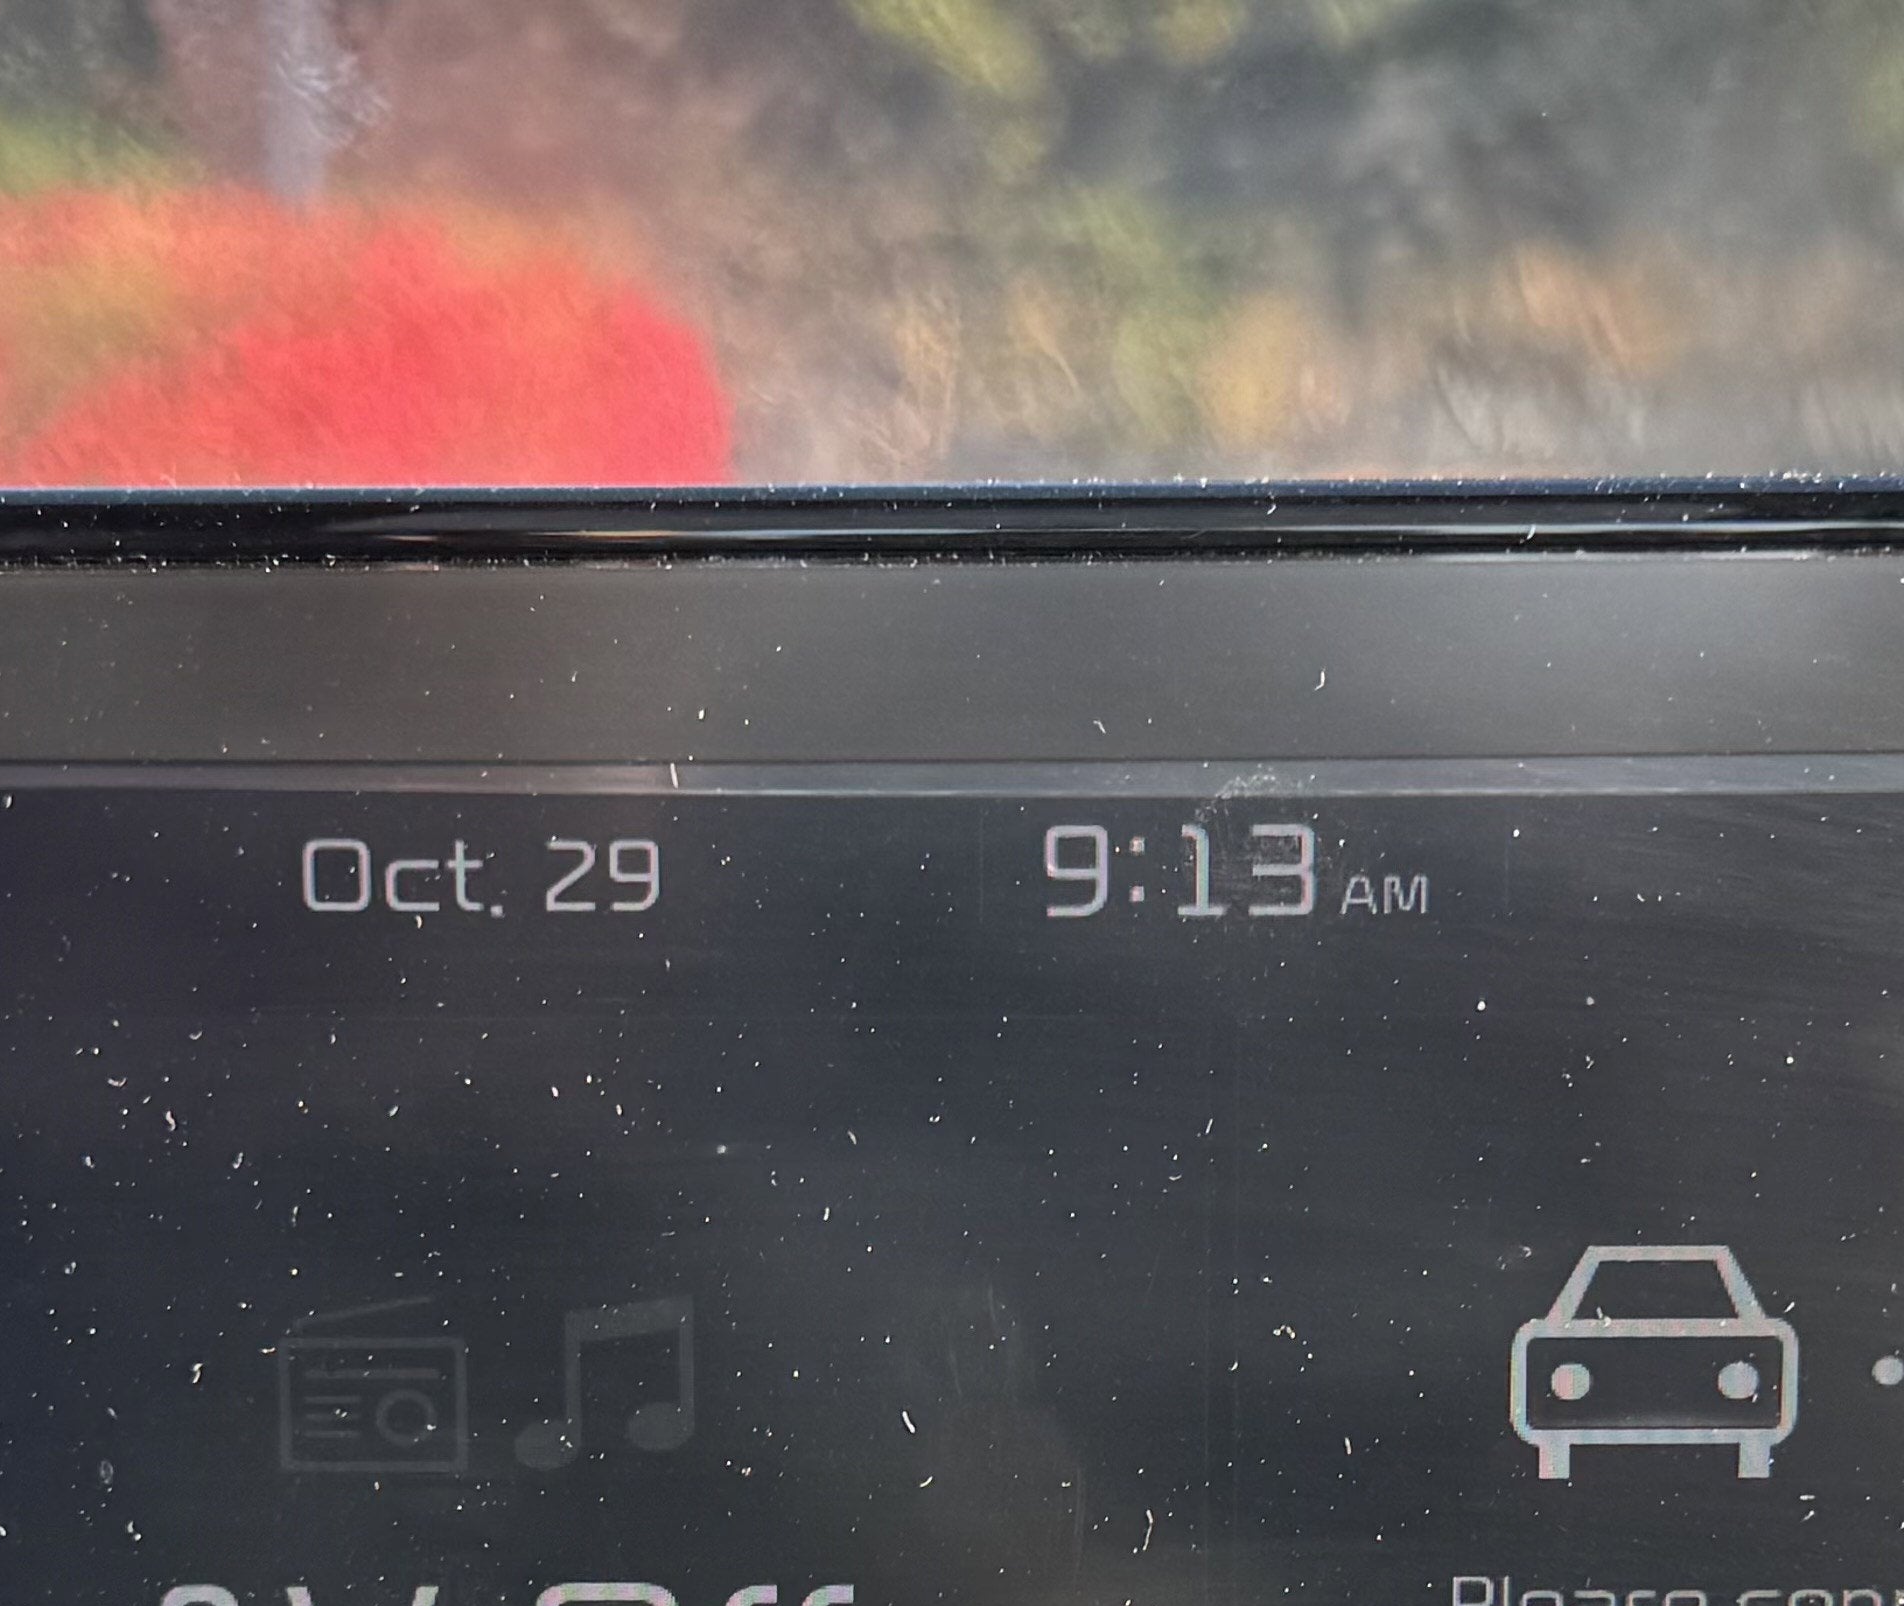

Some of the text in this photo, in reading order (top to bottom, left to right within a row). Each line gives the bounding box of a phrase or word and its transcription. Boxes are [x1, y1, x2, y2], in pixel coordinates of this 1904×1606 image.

[300, 836, 664, 920] Oct. 29
[1040, 820, 1432, 922] 9:13 AM
